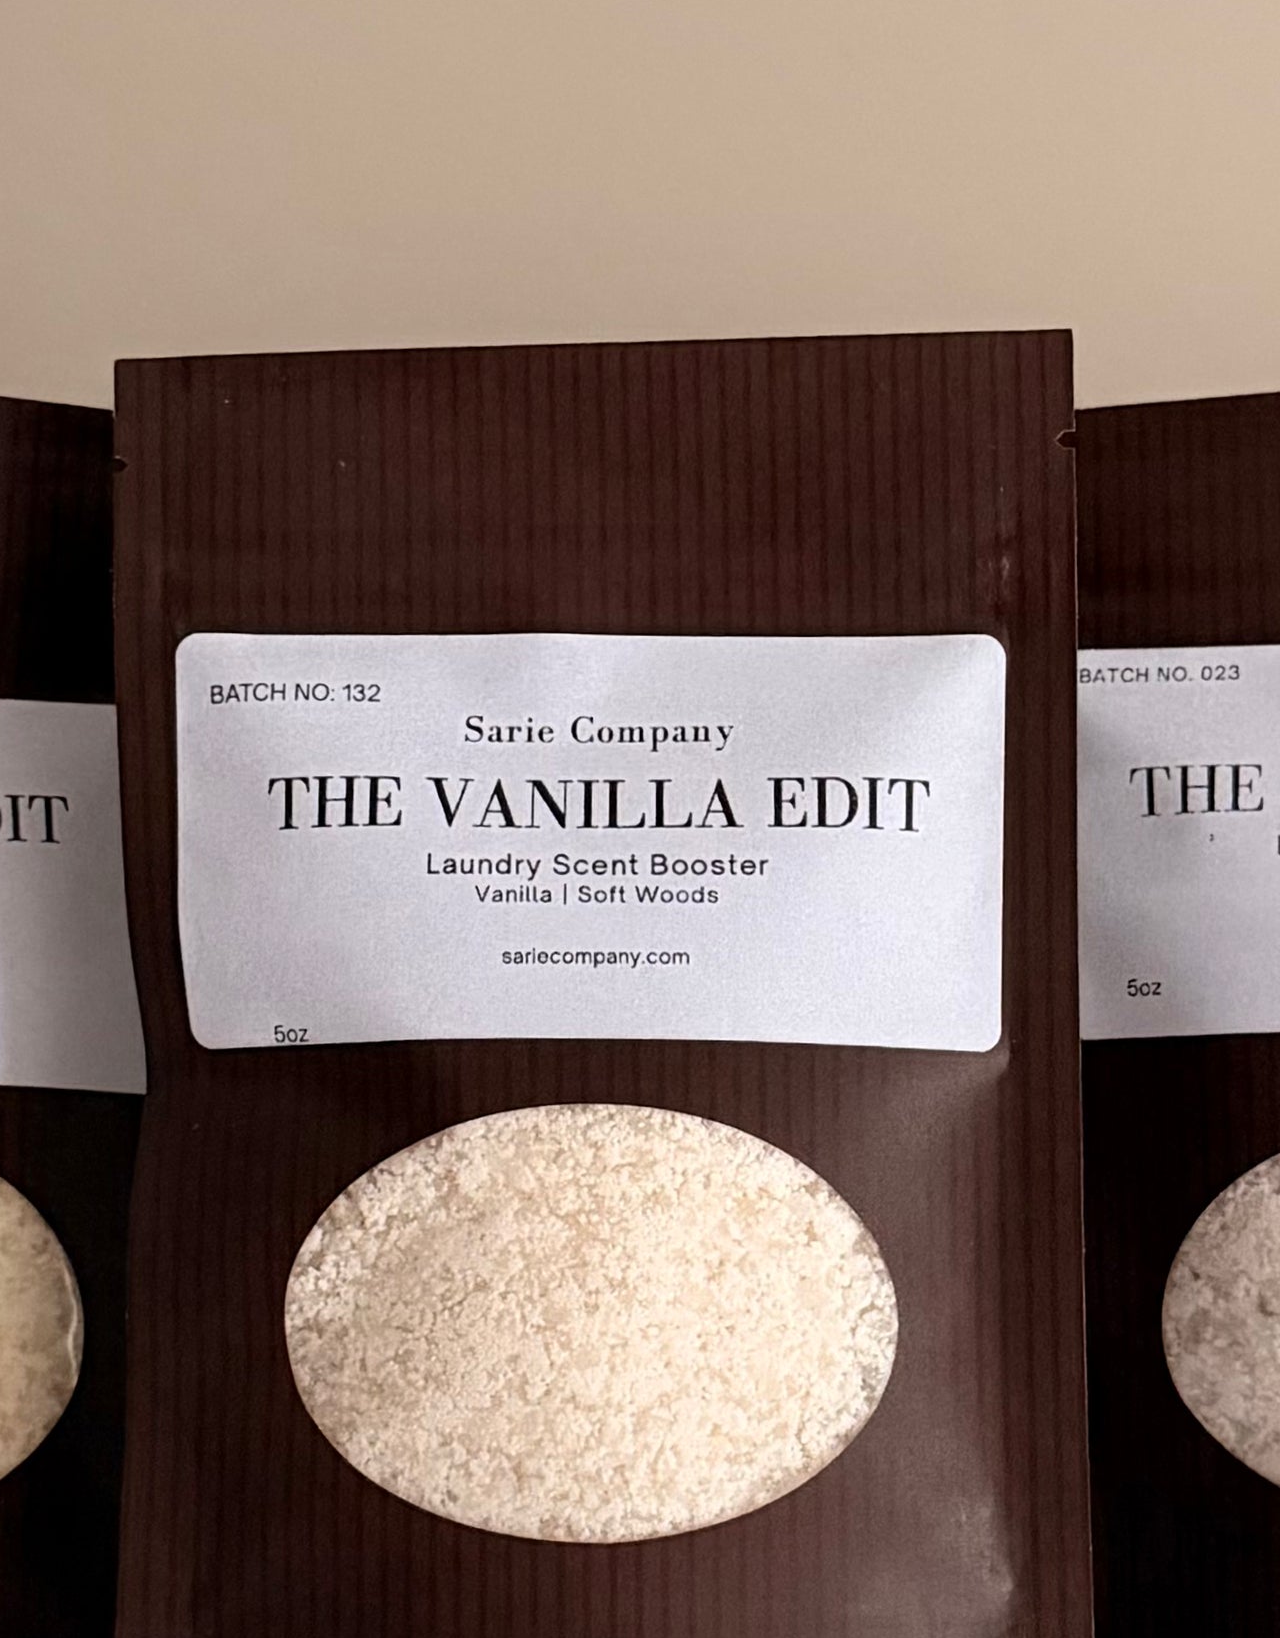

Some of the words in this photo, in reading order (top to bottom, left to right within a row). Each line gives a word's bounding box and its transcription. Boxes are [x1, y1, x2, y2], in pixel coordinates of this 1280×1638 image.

[1078, 667, 1150, 684] BATCH
[1200, 664, 1241, 682] 023
[209, 682, 287, 705] BATCH
[294, 682, 335, 702] NO:
[342, 683, 381, 703] 132
[464, 715, 554, 743] Sarie
[570, 715, 734, 753] Company
[1129, 764, 1264, 818] THE
[267, 775, 402, 831] THE
[426, 776, 745, 829] VANILLA
[766, 776, 931, 832] EDIT
[426, 852, 542, 882] Laundry
[552, 853, 639, 876] Scent
[650, 853, 769, 876] Booster
[474, 884, 552, 904] Vanilla
[577, 884, 626, 904] Soft
[634, 885, 719, 904] Woods
[501, 947, 690, 969] sariecompany.com
[1126, 978, 1162, 998] 5oz
[273, 1024, 310, 1044] 5oz
